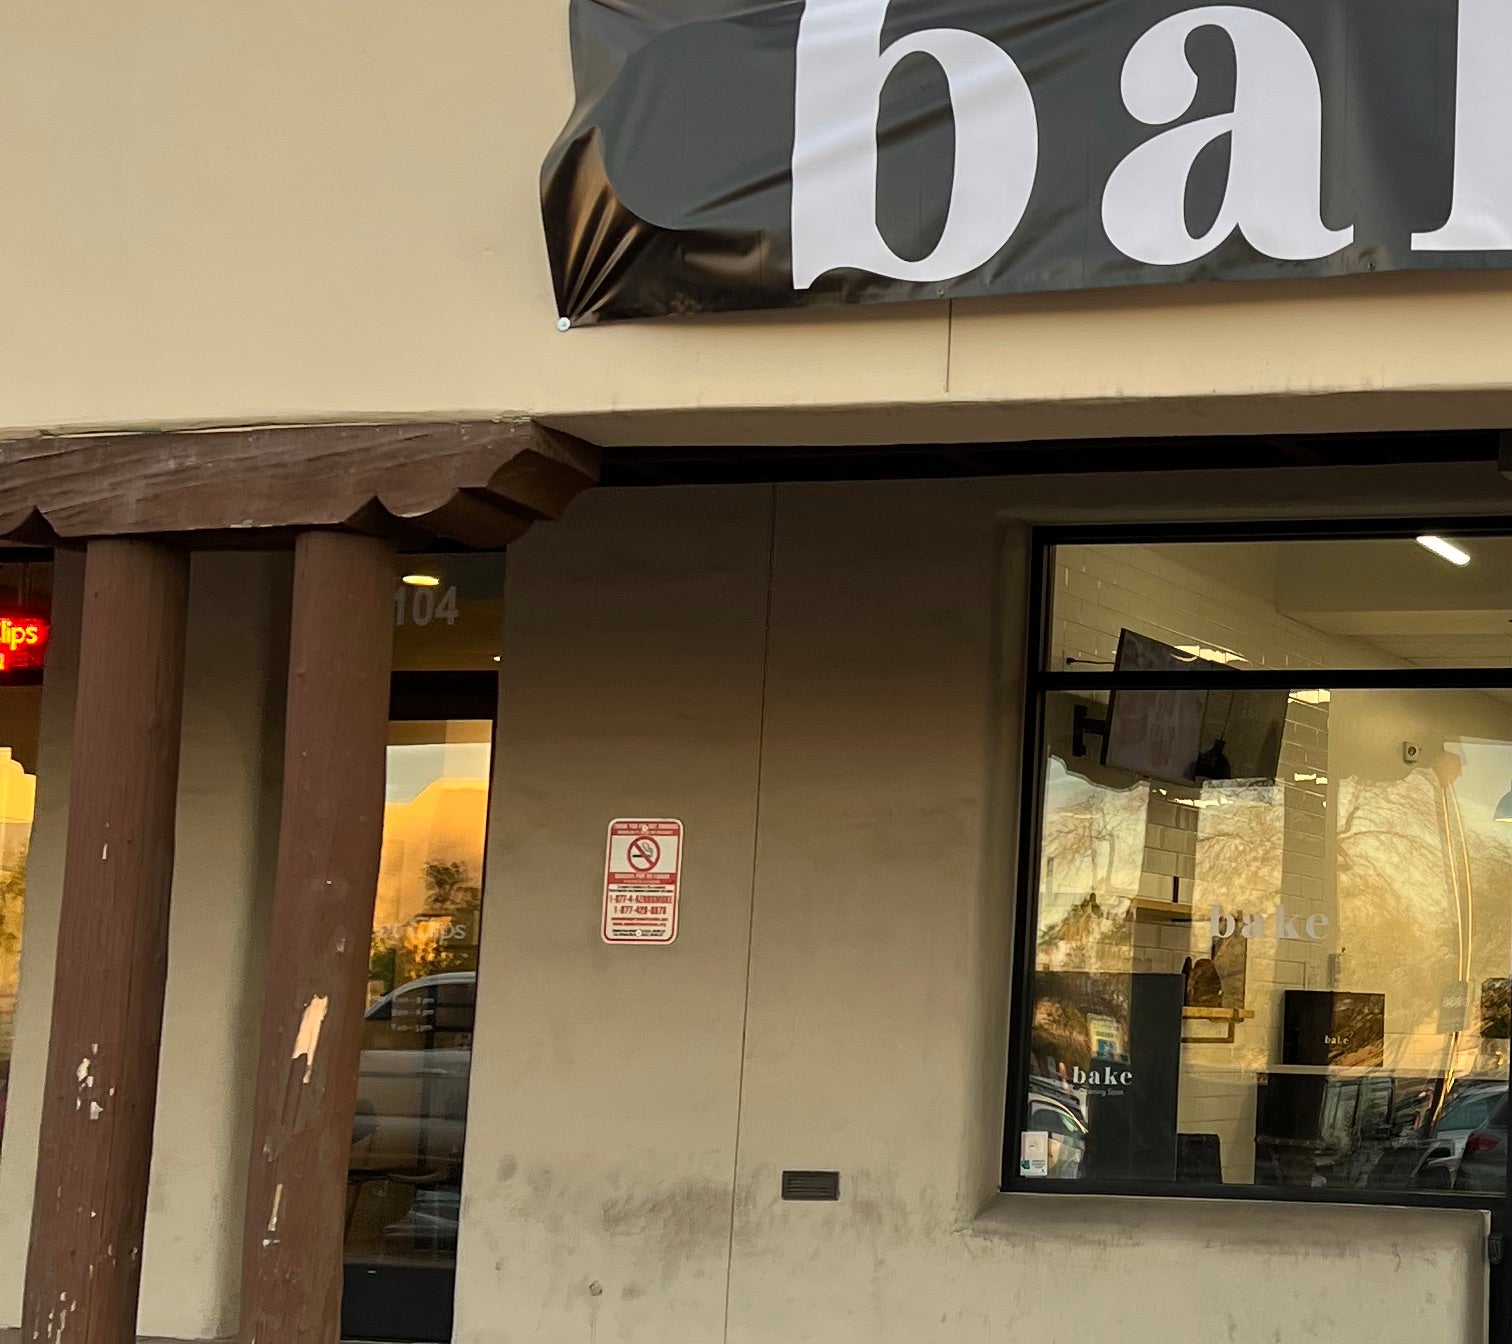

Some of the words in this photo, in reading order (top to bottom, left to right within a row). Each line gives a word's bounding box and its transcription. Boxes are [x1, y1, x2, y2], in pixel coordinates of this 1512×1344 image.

[394, 585, 459, 626] 104
[0, 619, 38, 650] lips
[1210, 904, 1329, 940] bake
[1073, 1066, 1132, 1086] bake
